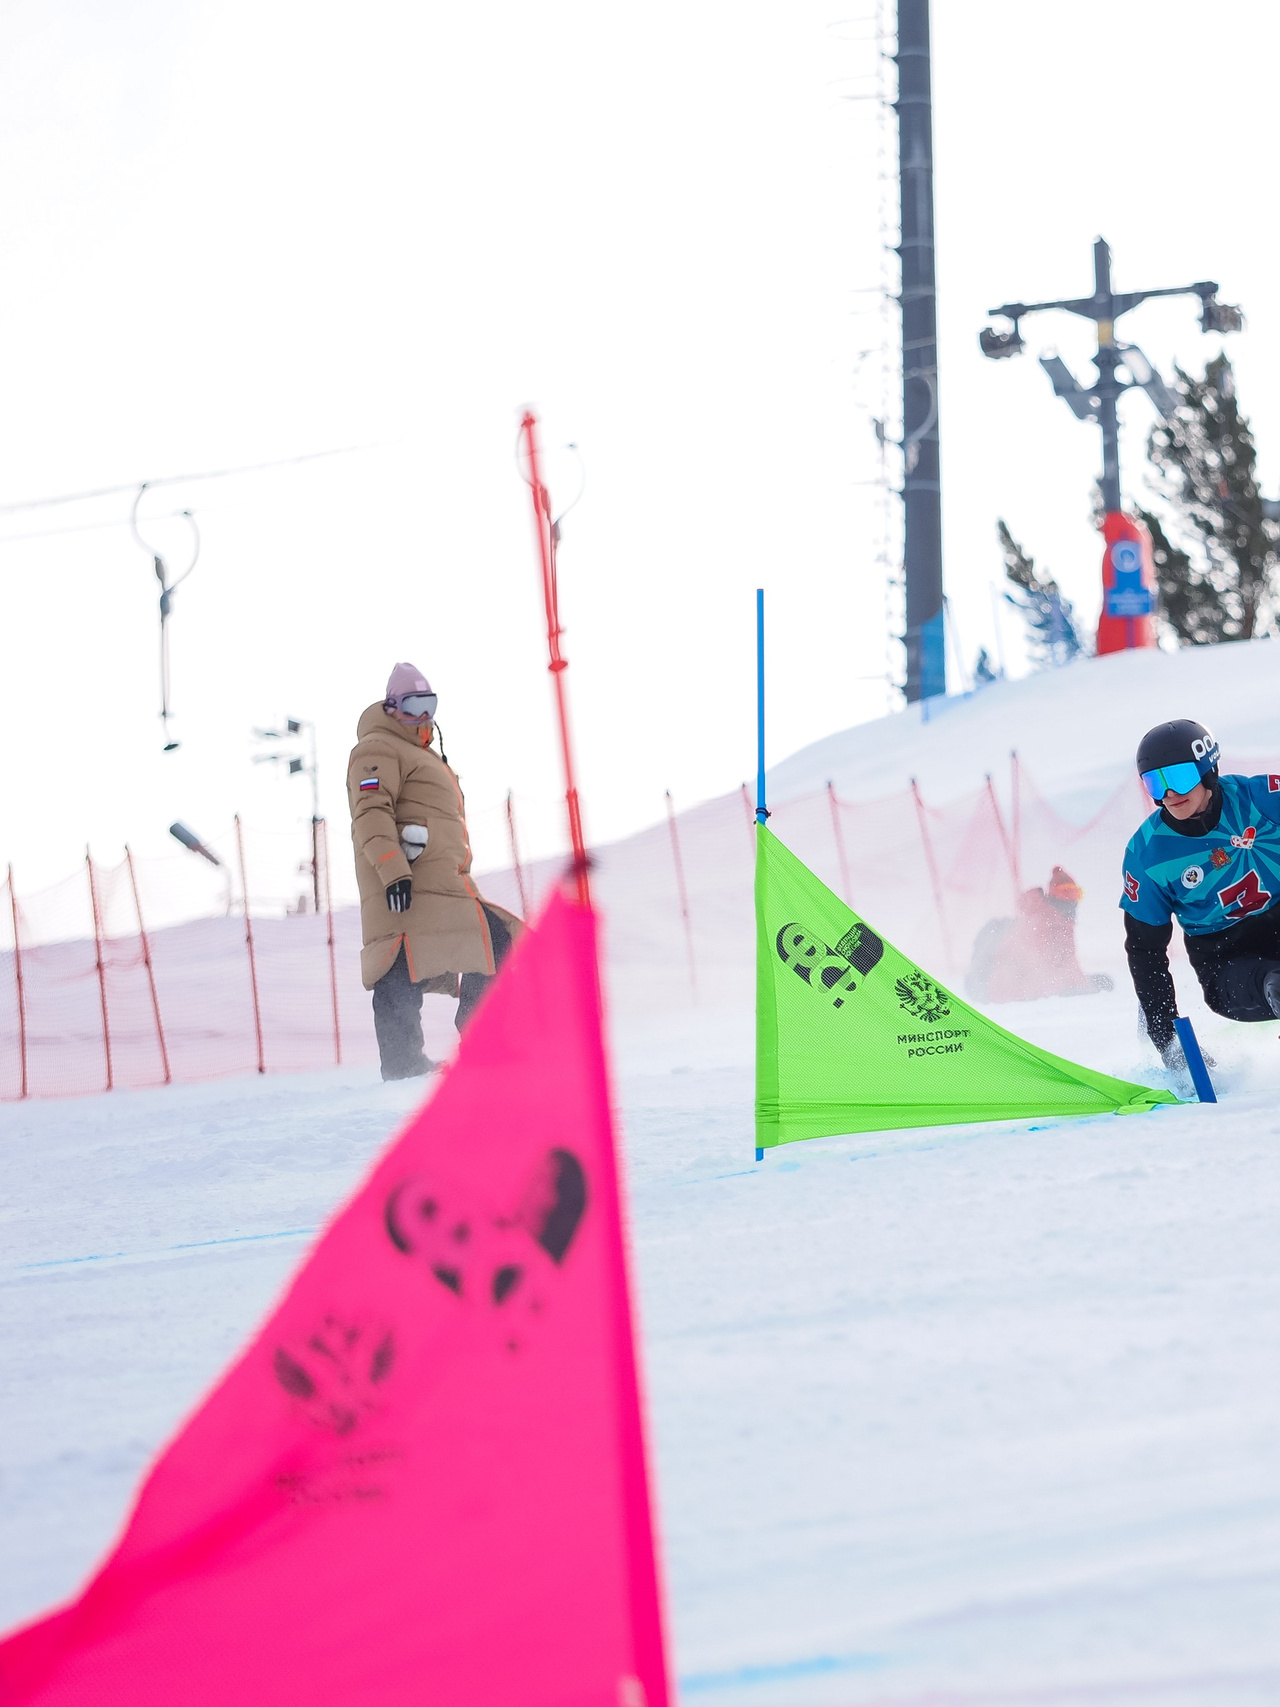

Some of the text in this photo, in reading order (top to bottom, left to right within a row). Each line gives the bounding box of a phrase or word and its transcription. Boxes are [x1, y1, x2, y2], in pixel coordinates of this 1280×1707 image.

[1122, 869, 1140, 903] 3
[1216, 867, 1273, 920] 3
[897, 1029, 970, 1045] МИНСПОРТ
[907, 1042, 964, 1059] РОССИИ
